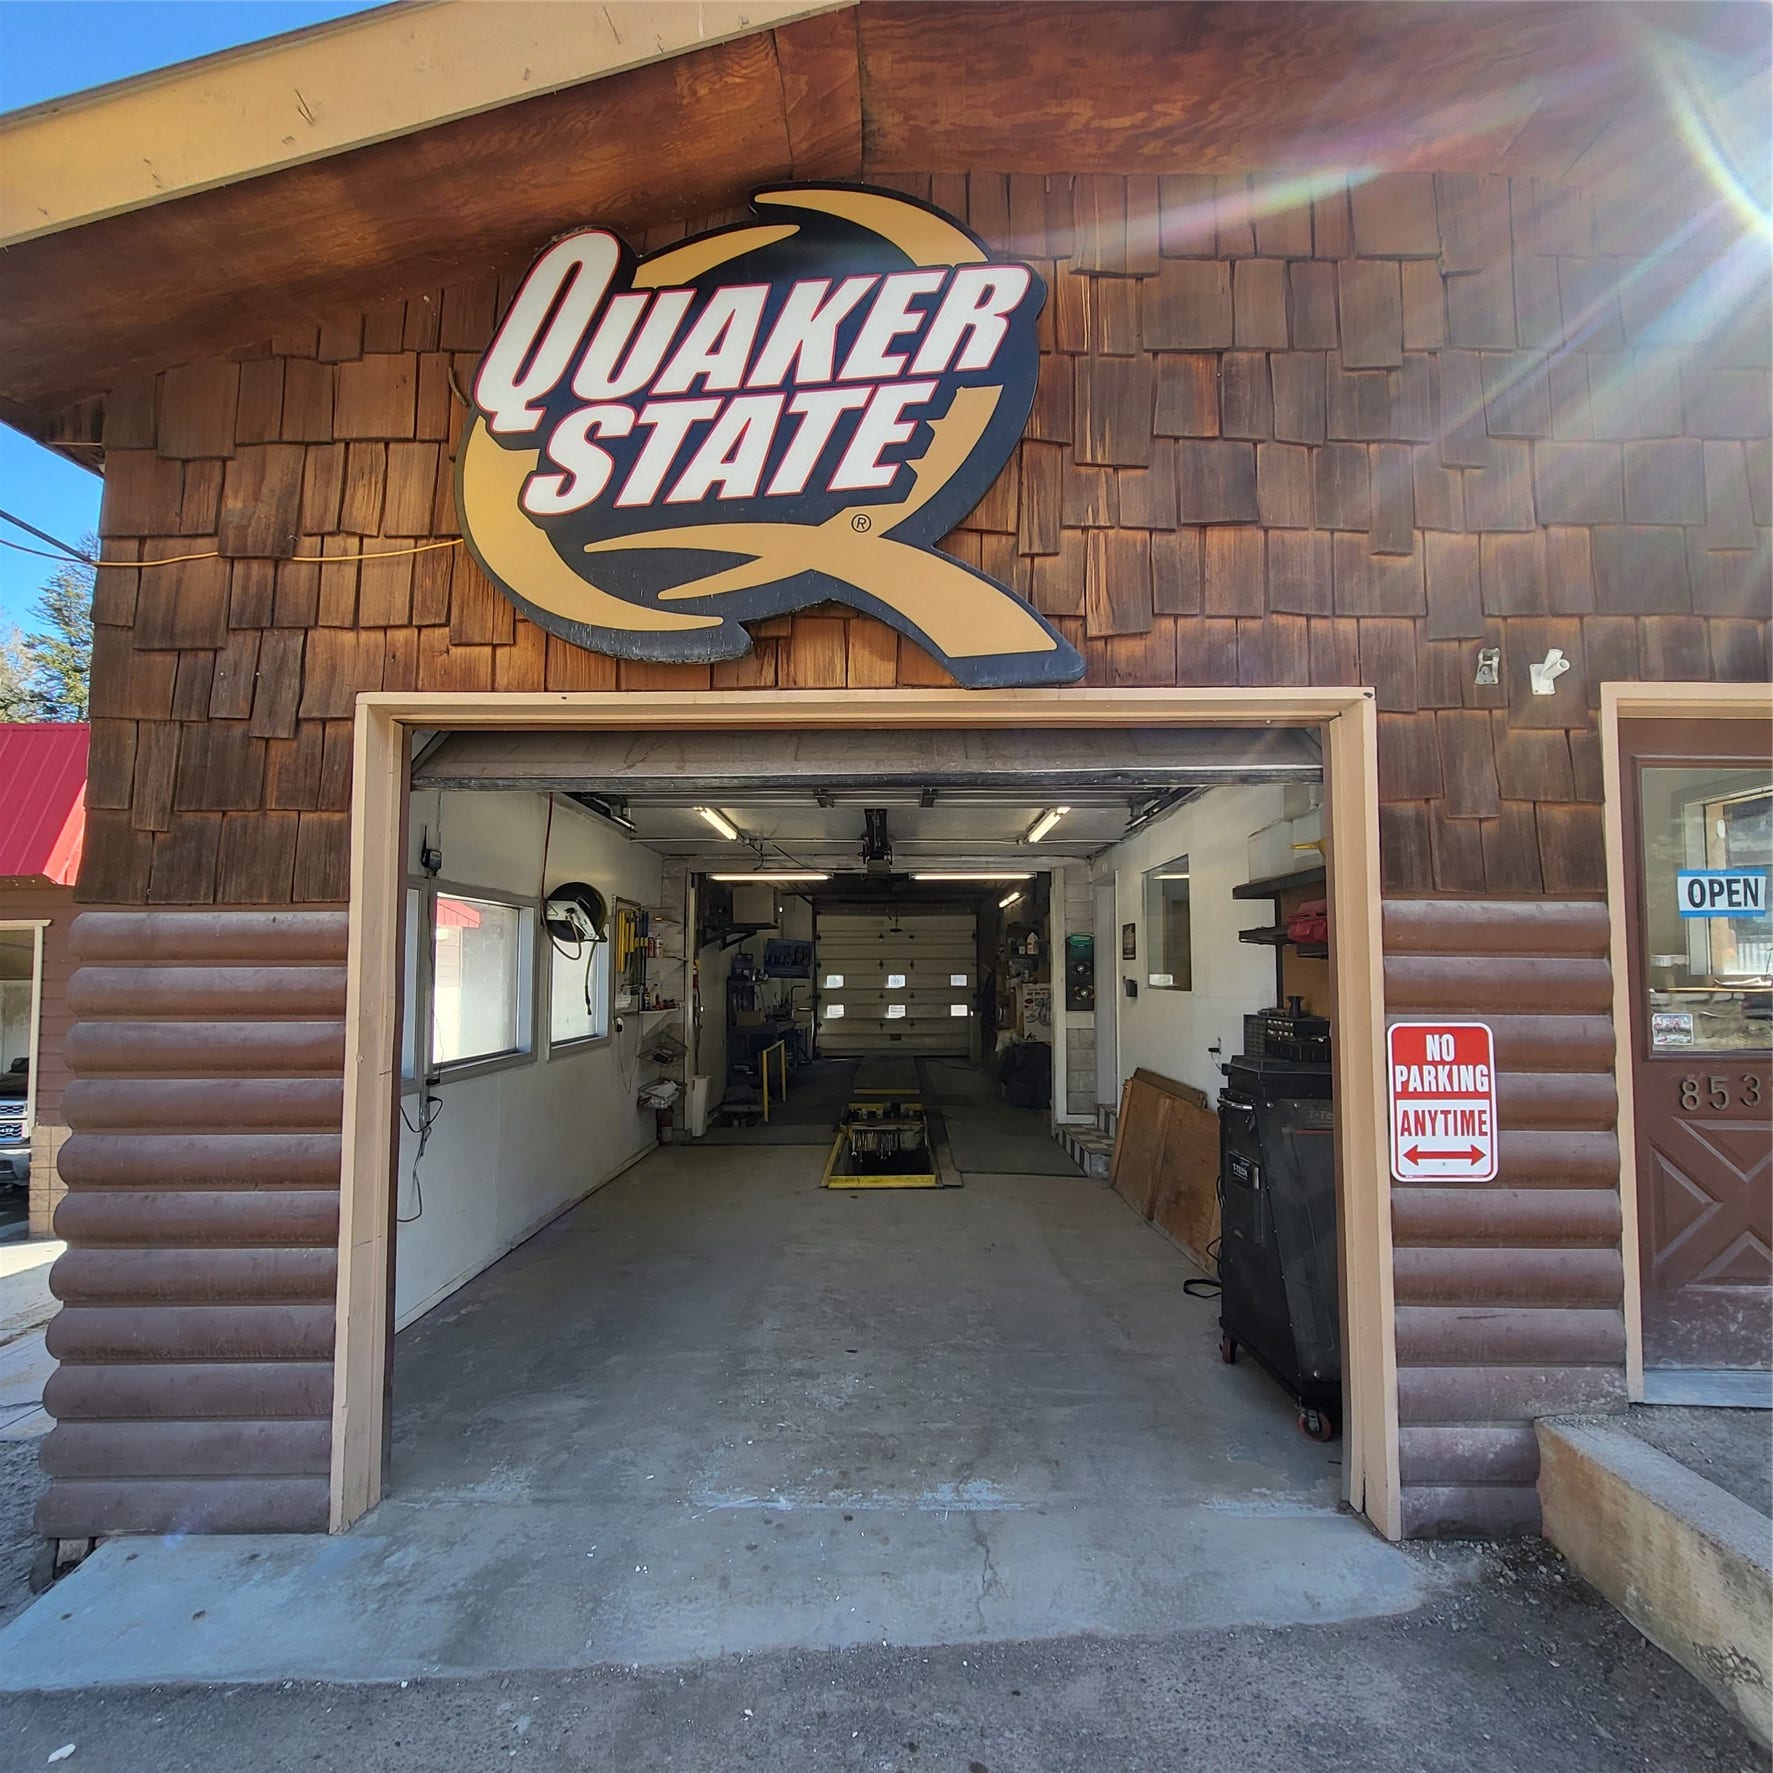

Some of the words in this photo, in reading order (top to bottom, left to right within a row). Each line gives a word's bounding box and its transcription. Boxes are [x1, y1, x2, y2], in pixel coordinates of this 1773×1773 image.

[475, 230, 1029, 433] QUAKER
[522, 380, 940, 516] STATE
[1687, 877, 1760, 909] OPEN
[1425, 1034, 1455, 1062] NO
[1395, 1064, 1490, 1093] PARKING
[1680, 1073, 1761, 1111] 853
[1400, 1109, 1489, 1137] ANYTIME
